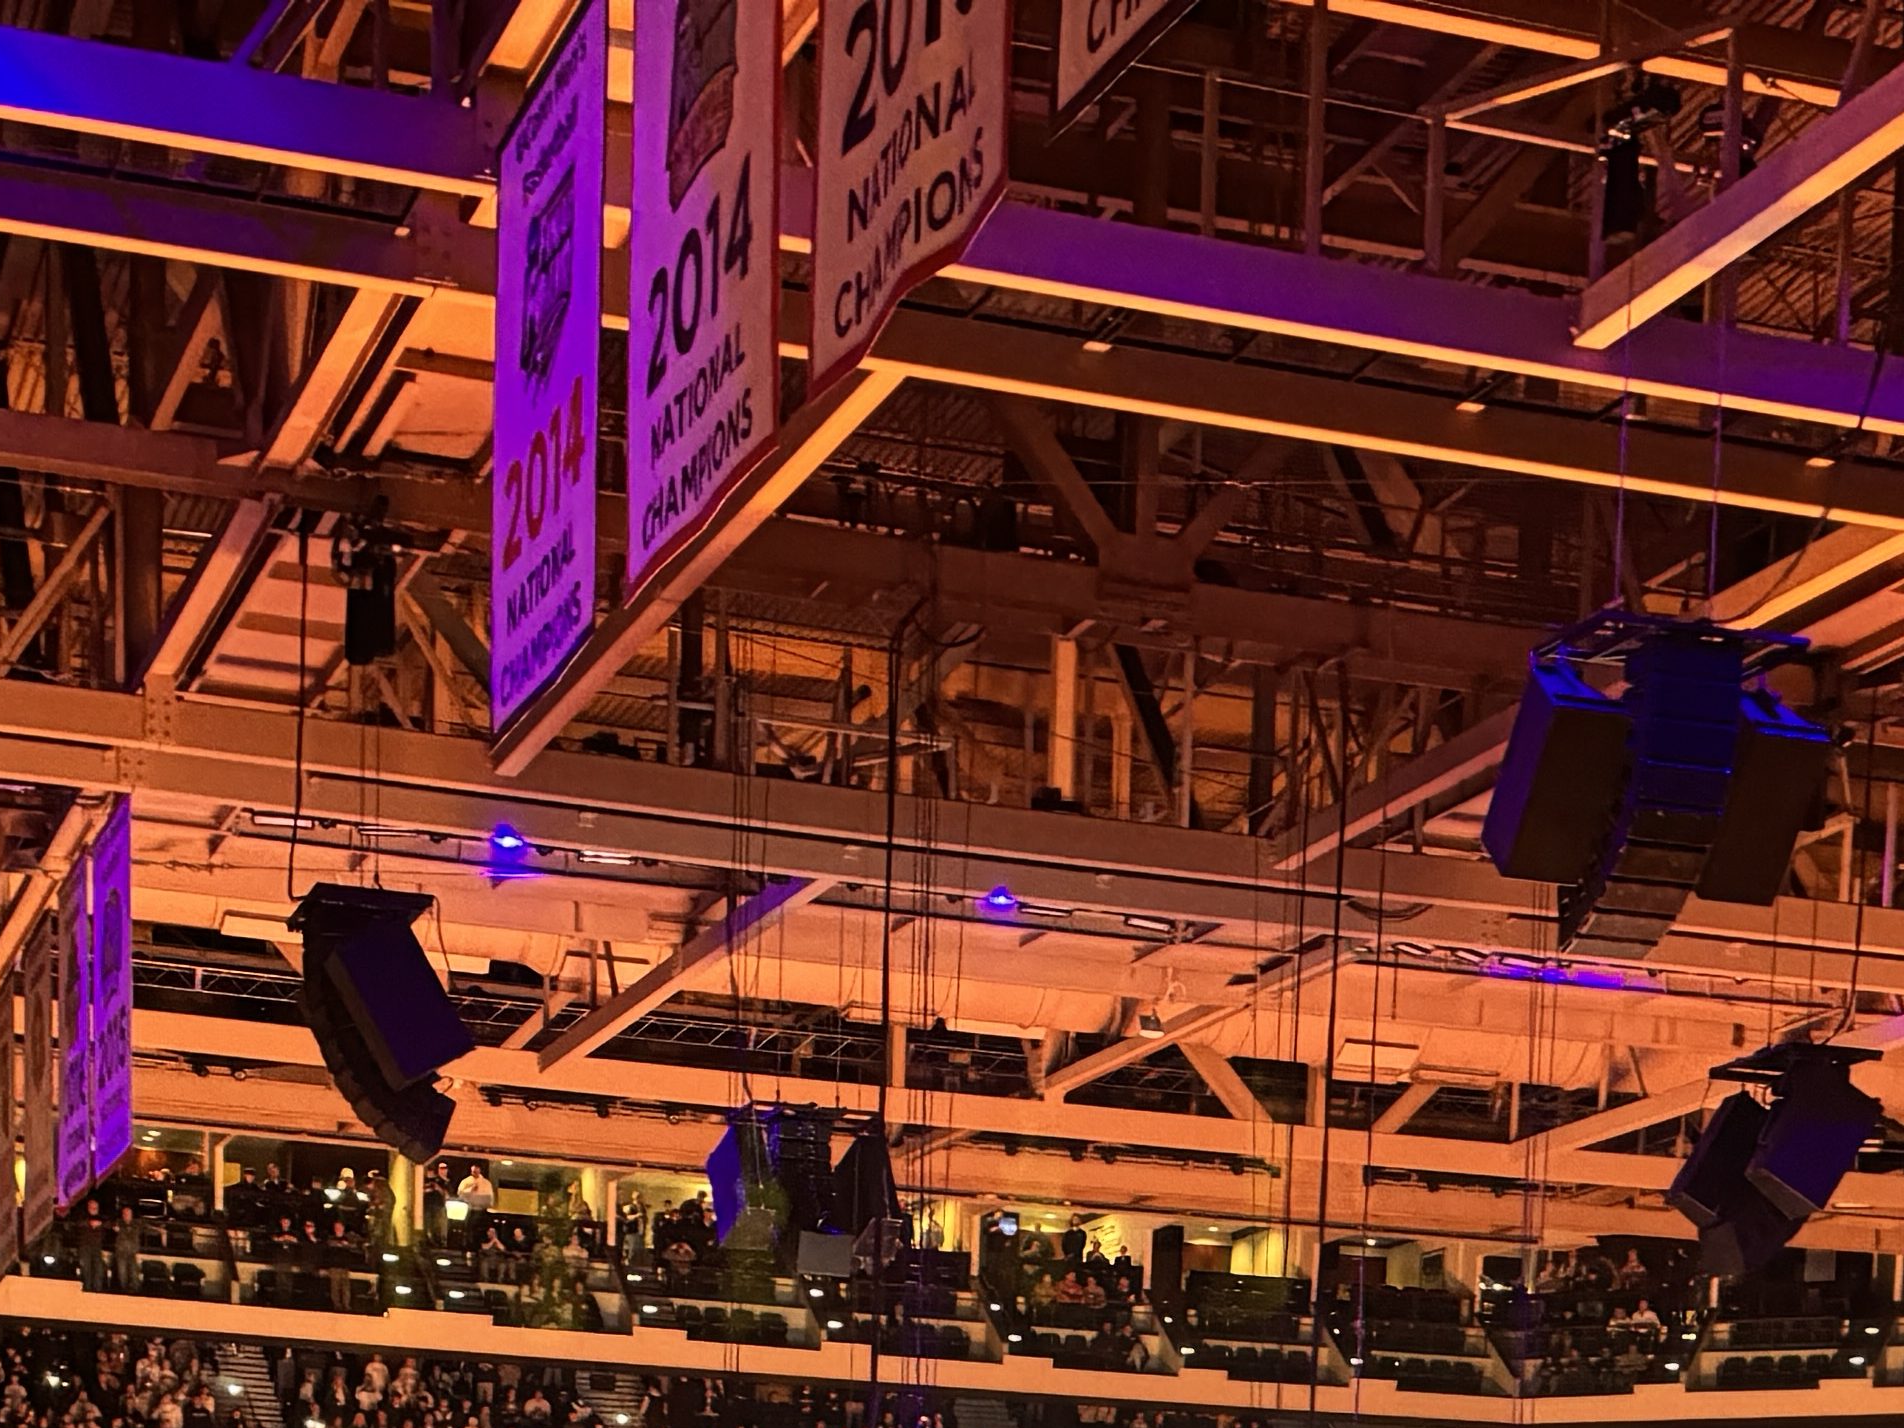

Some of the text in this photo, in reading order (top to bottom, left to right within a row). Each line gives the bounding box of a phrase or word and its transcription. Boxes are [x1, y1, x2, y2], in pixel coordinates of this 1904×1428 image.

[833, 126, 984, 338] CHAMPIONS
[846, 48, 975, 242] NATIONAL
[647, 150, 752, 399] 2014
[502, 374, 585, 571] 2014
[642, 387, 752, 551] CHAMPIONS
[650, 322, 744, 470] NATIONAL
[500, 580, 582, 706] CHAMPIONS
[506, 521, 576, 636] NATIONAL
